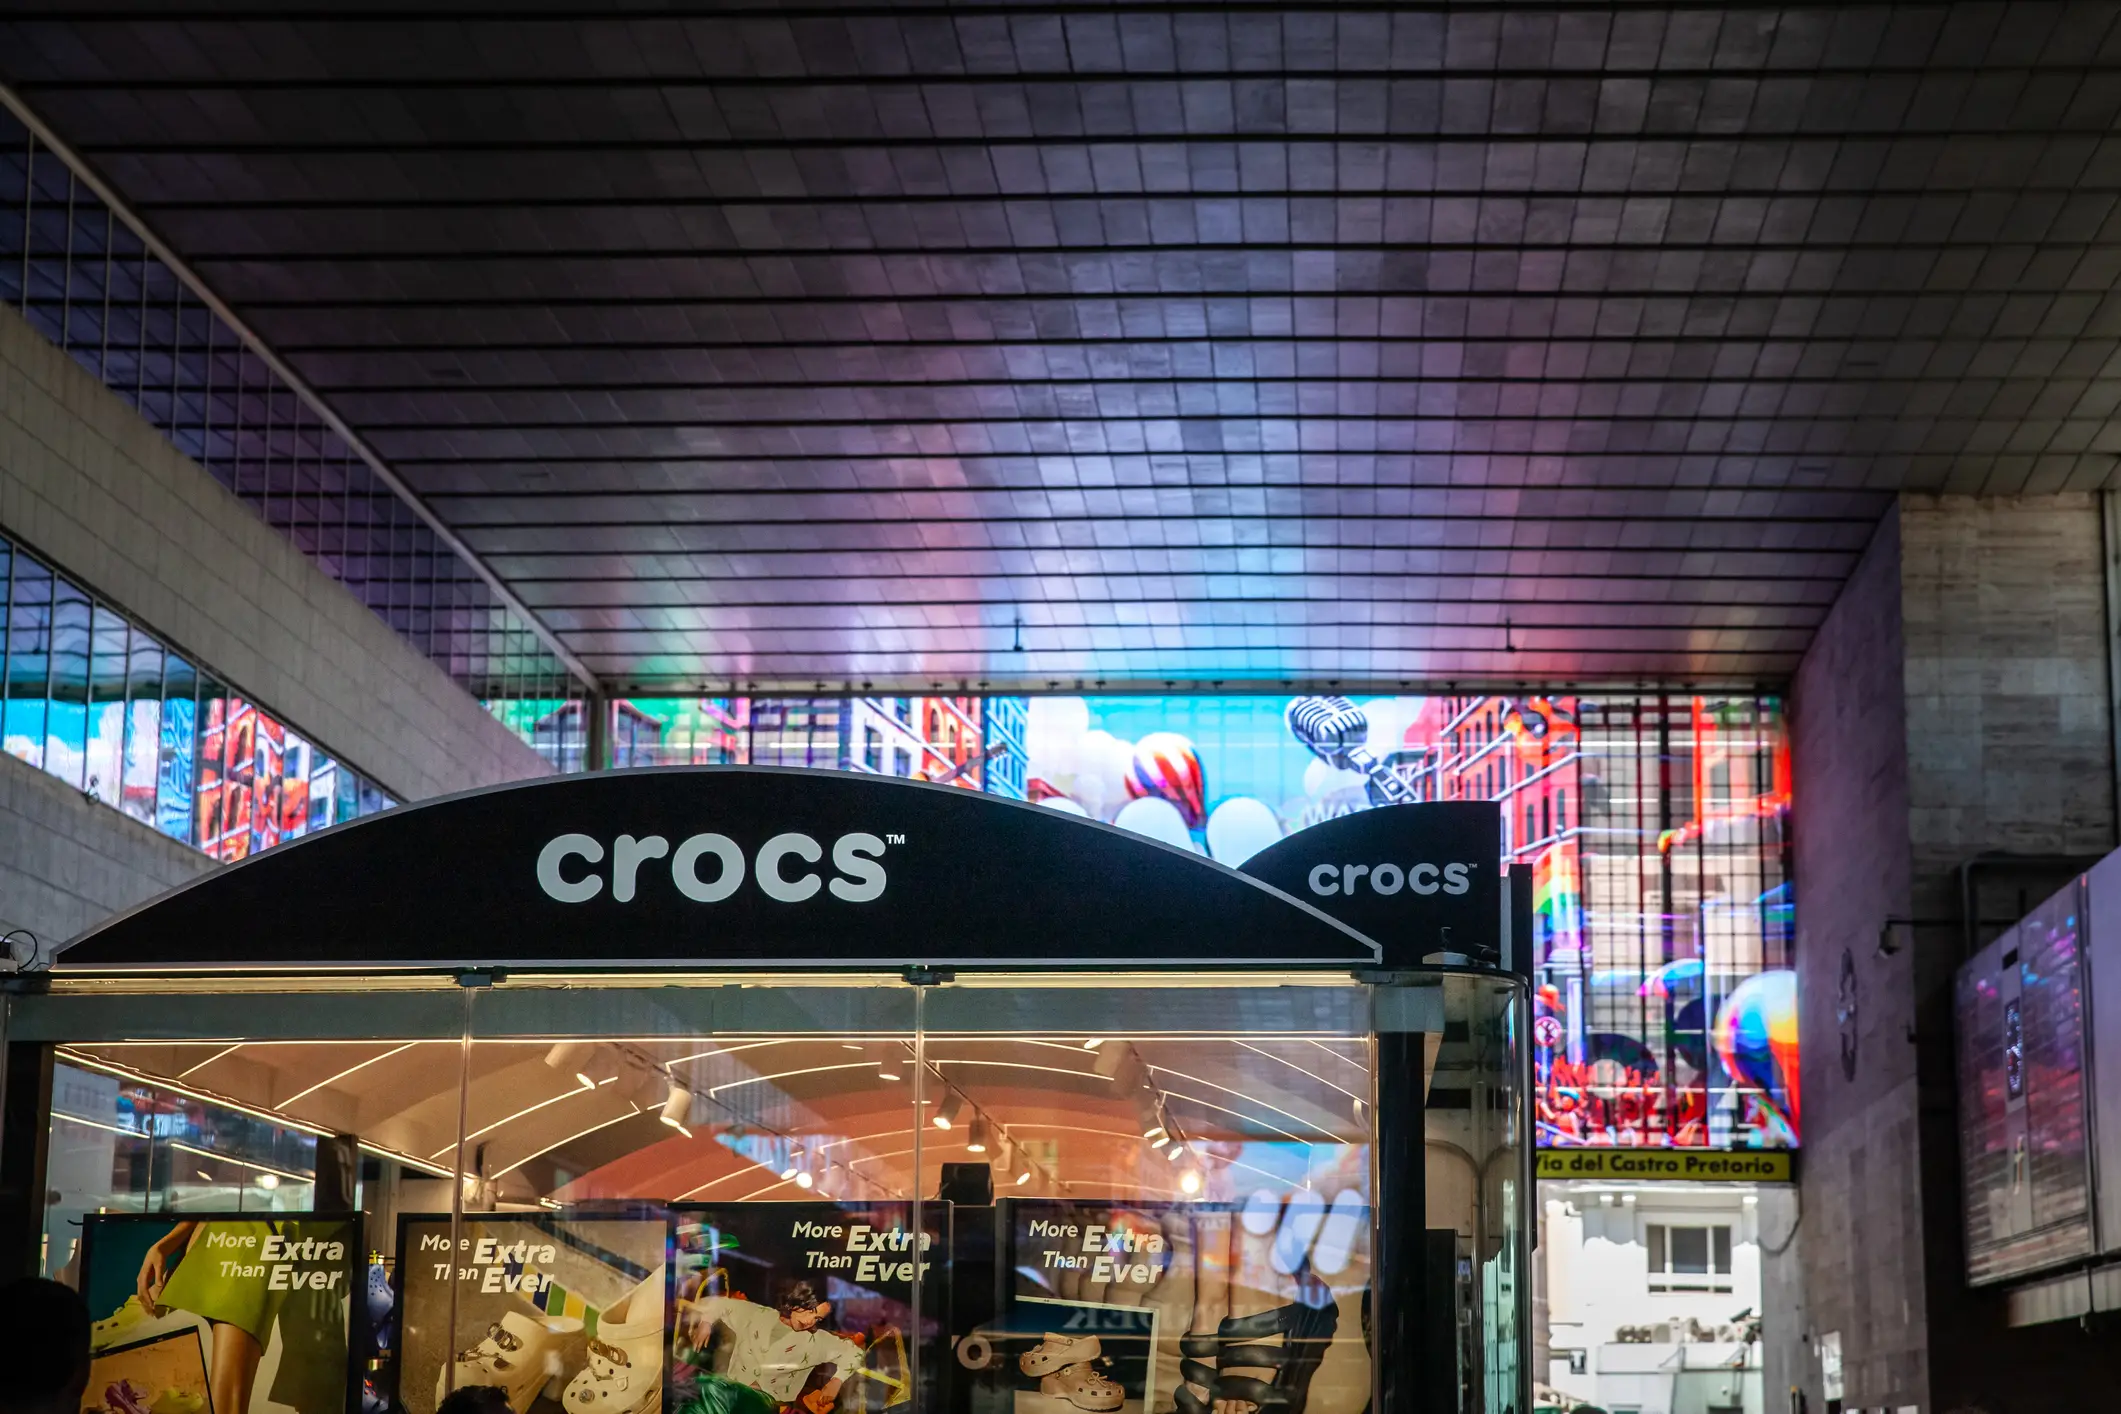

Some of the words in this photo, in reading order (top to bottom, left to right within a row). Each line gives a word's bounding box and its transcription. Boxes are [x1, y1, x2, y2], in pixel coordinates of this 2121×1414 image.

[1570, 1155, 1603, 1171] del
[1610, 1157, 1679, 1172] Castro
[1686, 1157, 1776, 1174] Pretorio
[792, 1221, 842, 1238] More
[1029, 1220, 1078, 1237] More
[1082, 1225, 1164, 1253] Extra
[206, 1232, 256, 1248] More
[260, 1235, 344, 1261] Extra
[420, 1235, 469, 1251] Moe
[473, 1238, 556, 1264] Extra
[806, 1251, 852, 1268] Than
[220, 1261, 265, 1277] Than
[268, 1265, 343, 1290] Ever
[481, 1267, 554, 1293] Ever
[1043, 1251, 1087, 1268] Than
[1091, 1256, 1163, 1283] Ever
